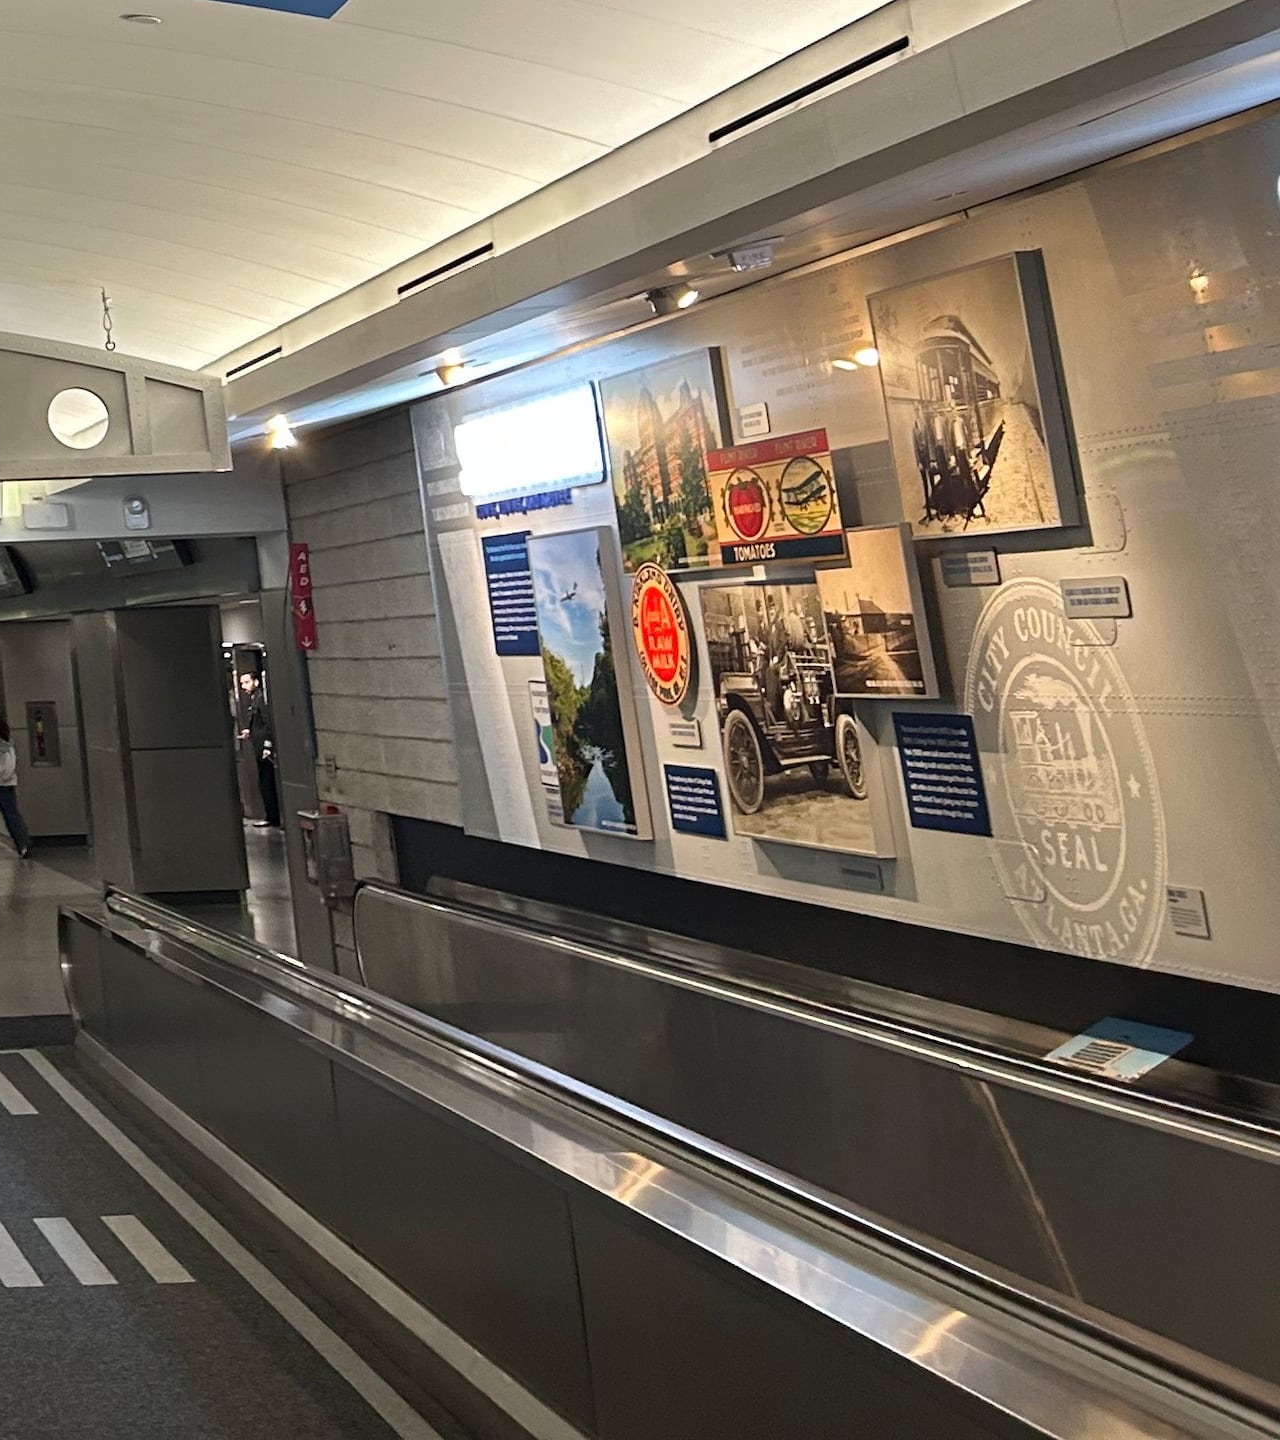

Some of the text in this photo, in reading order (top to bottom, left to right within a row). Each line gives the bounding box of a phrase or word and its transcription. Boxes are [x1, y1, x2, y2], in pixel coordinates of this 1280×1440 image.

[297, 551, 309, 586] AED
[733, 543, 776, 562] TOMATOES
[648, 634, 673, 651] RAW
[977, 606, 1112, 718] CITY COUNCIL
[1041, 829, 1108, 871] SEAL
